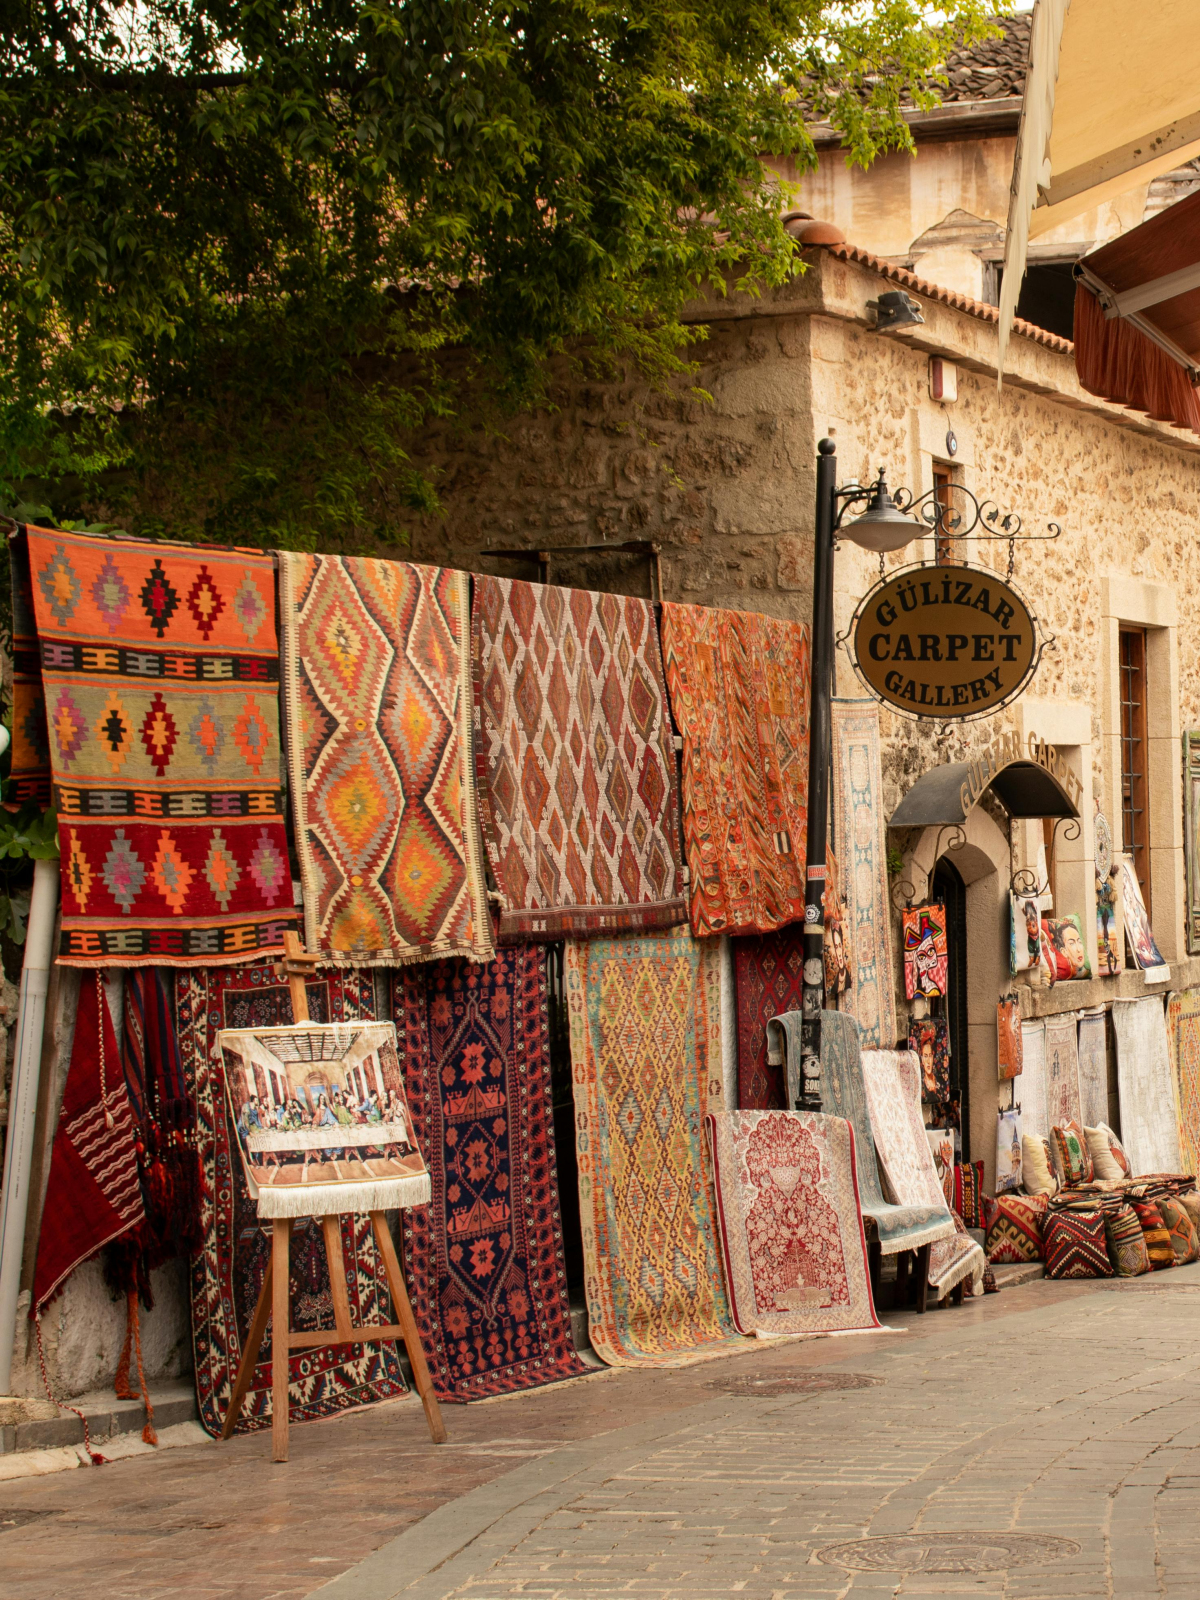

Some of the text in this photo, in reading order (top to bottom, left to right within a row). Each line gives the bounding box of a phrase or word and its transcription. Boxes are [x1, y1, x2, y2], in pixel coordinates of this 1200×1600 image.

[876, 574, 1016, 630] GÜLİZAR
[868, 634, 1022, 662] CARPET
[884, 666, 1004, 707] GALLERY
